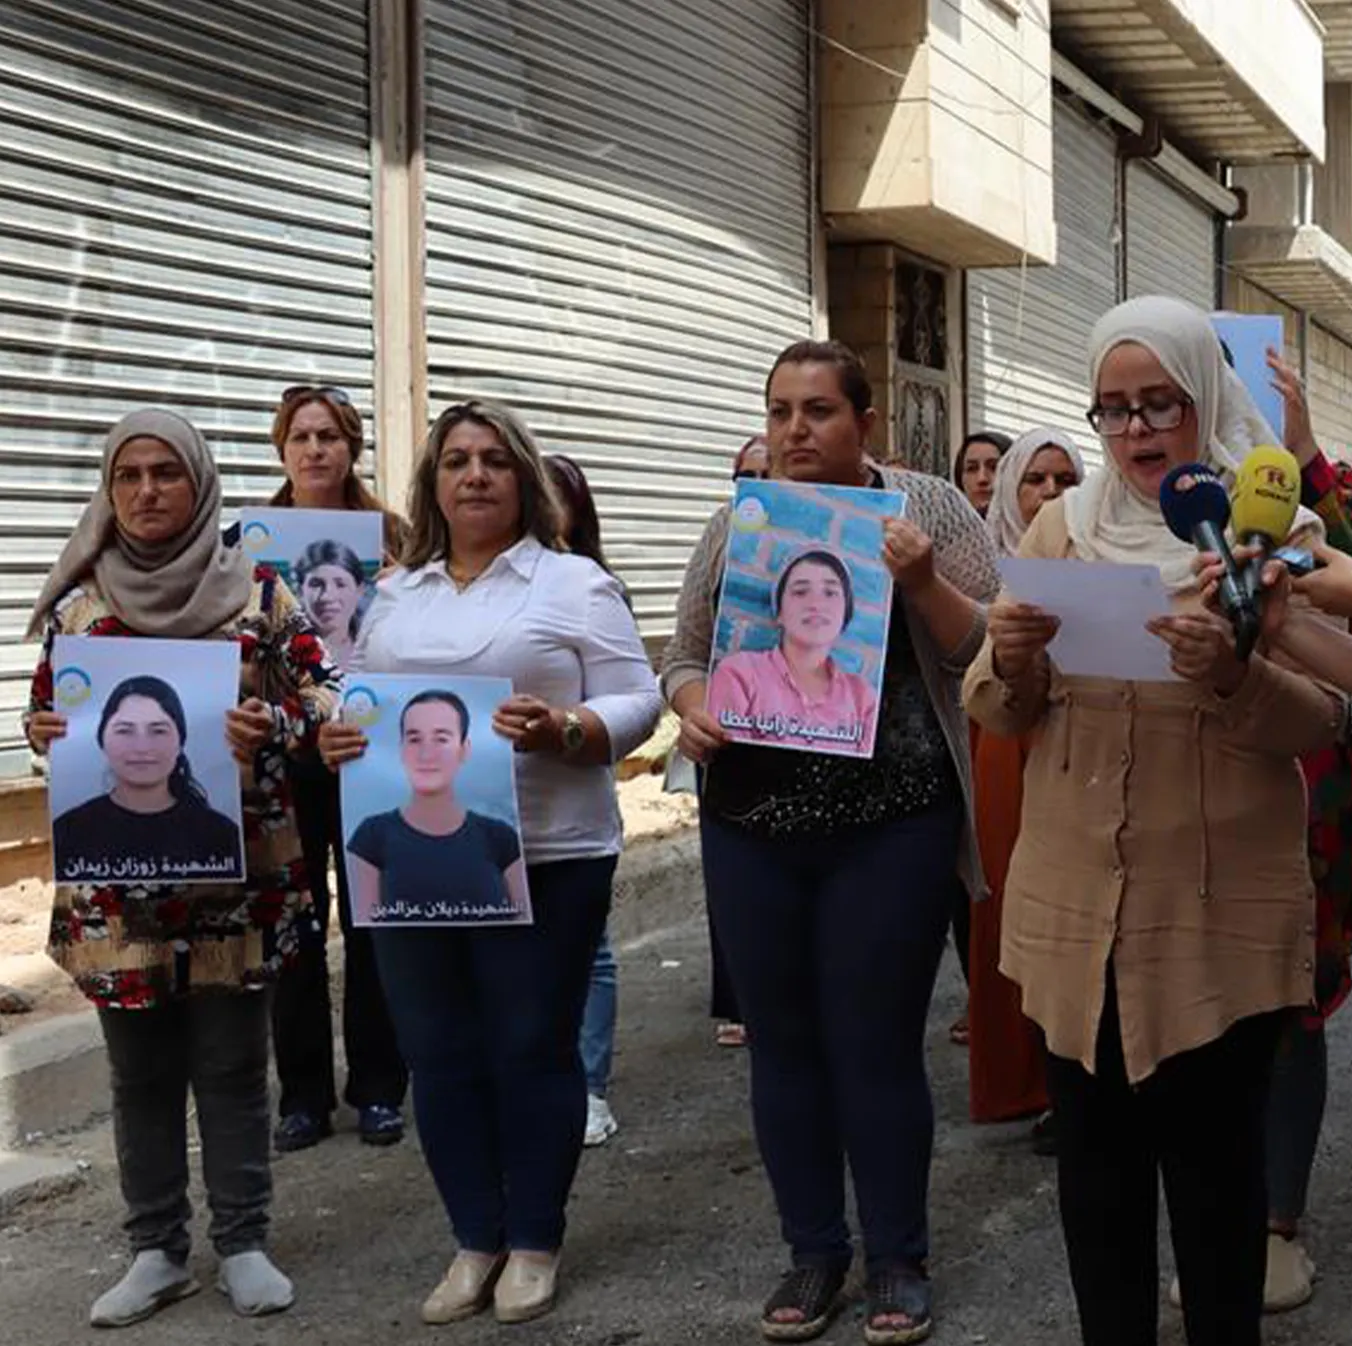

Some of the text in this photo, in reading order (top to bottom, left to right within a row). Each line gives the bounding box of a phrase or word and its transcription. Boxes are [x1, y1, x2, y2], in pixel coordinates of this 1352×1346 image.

[719, 709, 863, 743] الشهيدة رانيا عطا
[63, 855, 235, 877] الشهيدة زوزان زيدان
